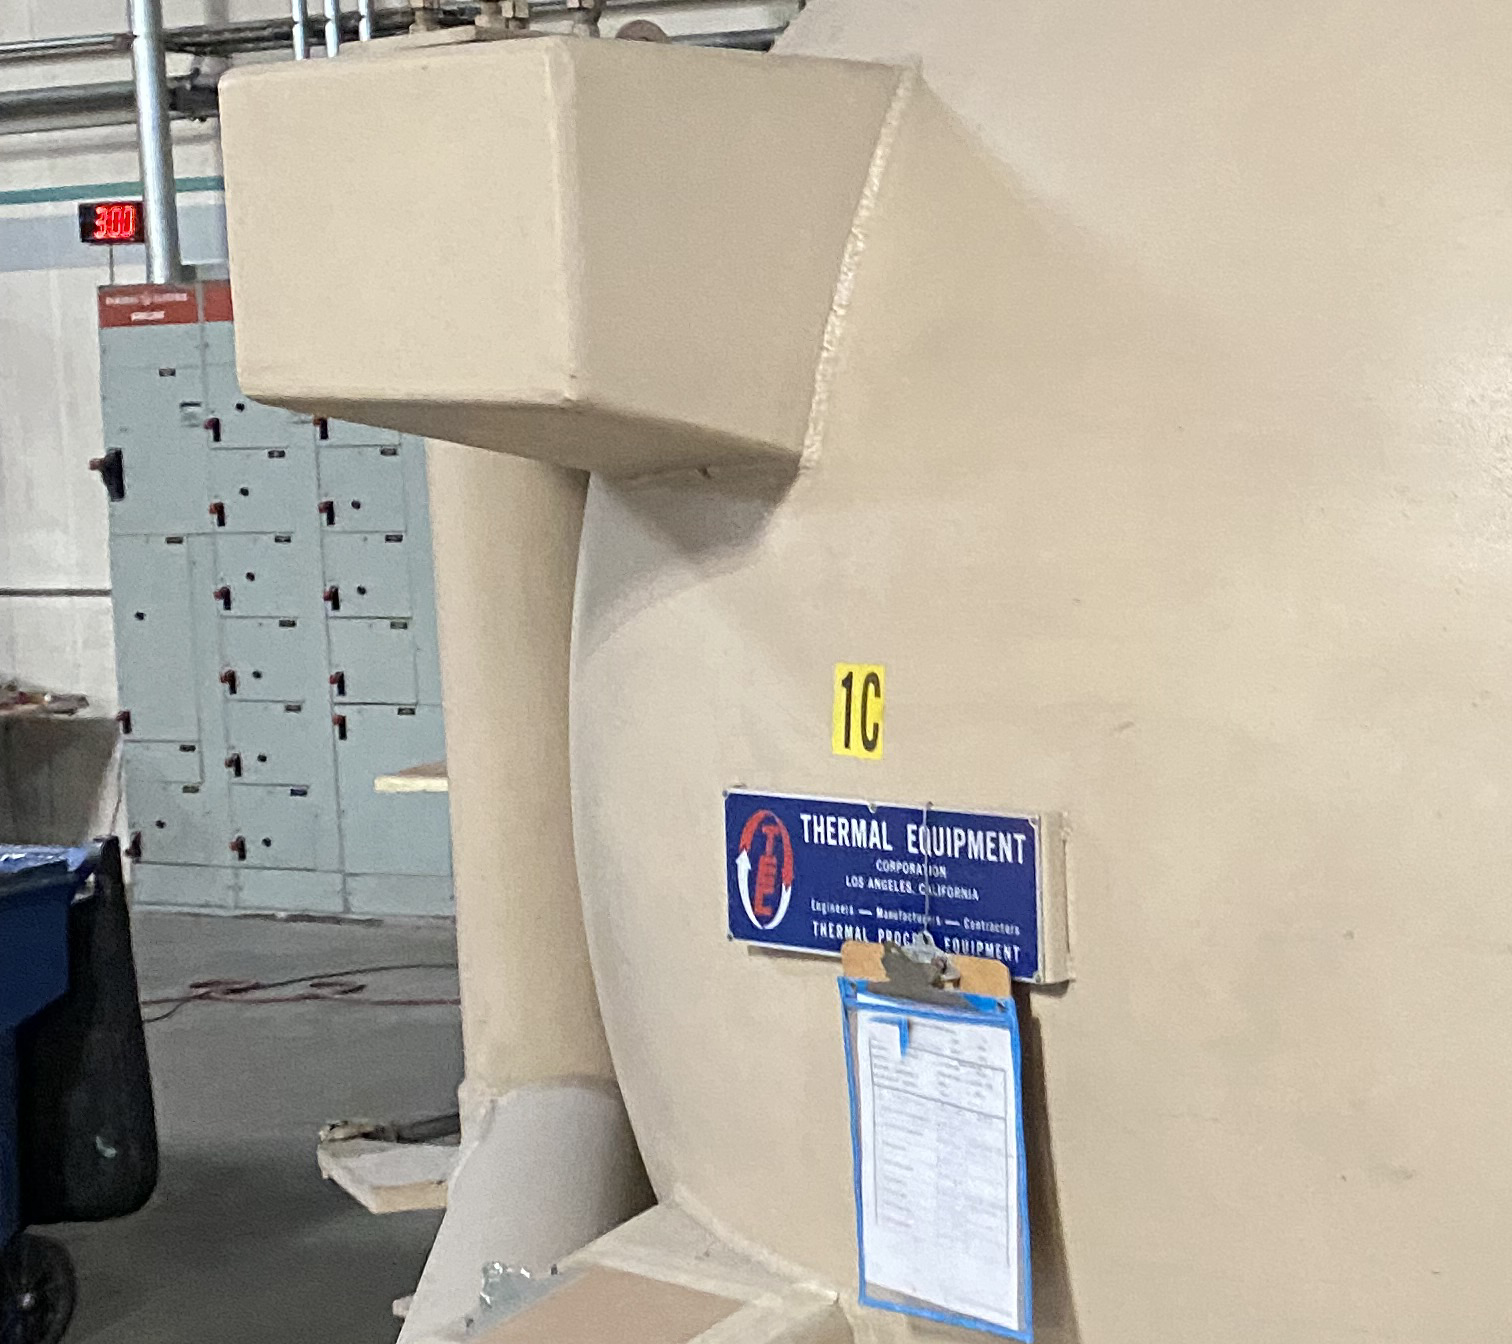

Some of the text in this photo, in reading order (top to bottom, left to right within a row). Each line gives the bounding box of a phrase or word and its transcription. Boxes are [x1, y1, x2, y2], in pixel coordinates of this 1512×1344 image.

[841, 671, 881, 752] 1C
[800, 813, 1026, 865] THERMAL EQUIPMENT
[845, 875, 865, 889] LOS
[812, 920, 869, 944] THERMAL
[944, 936, 1021, 964] EQUIPMENT
